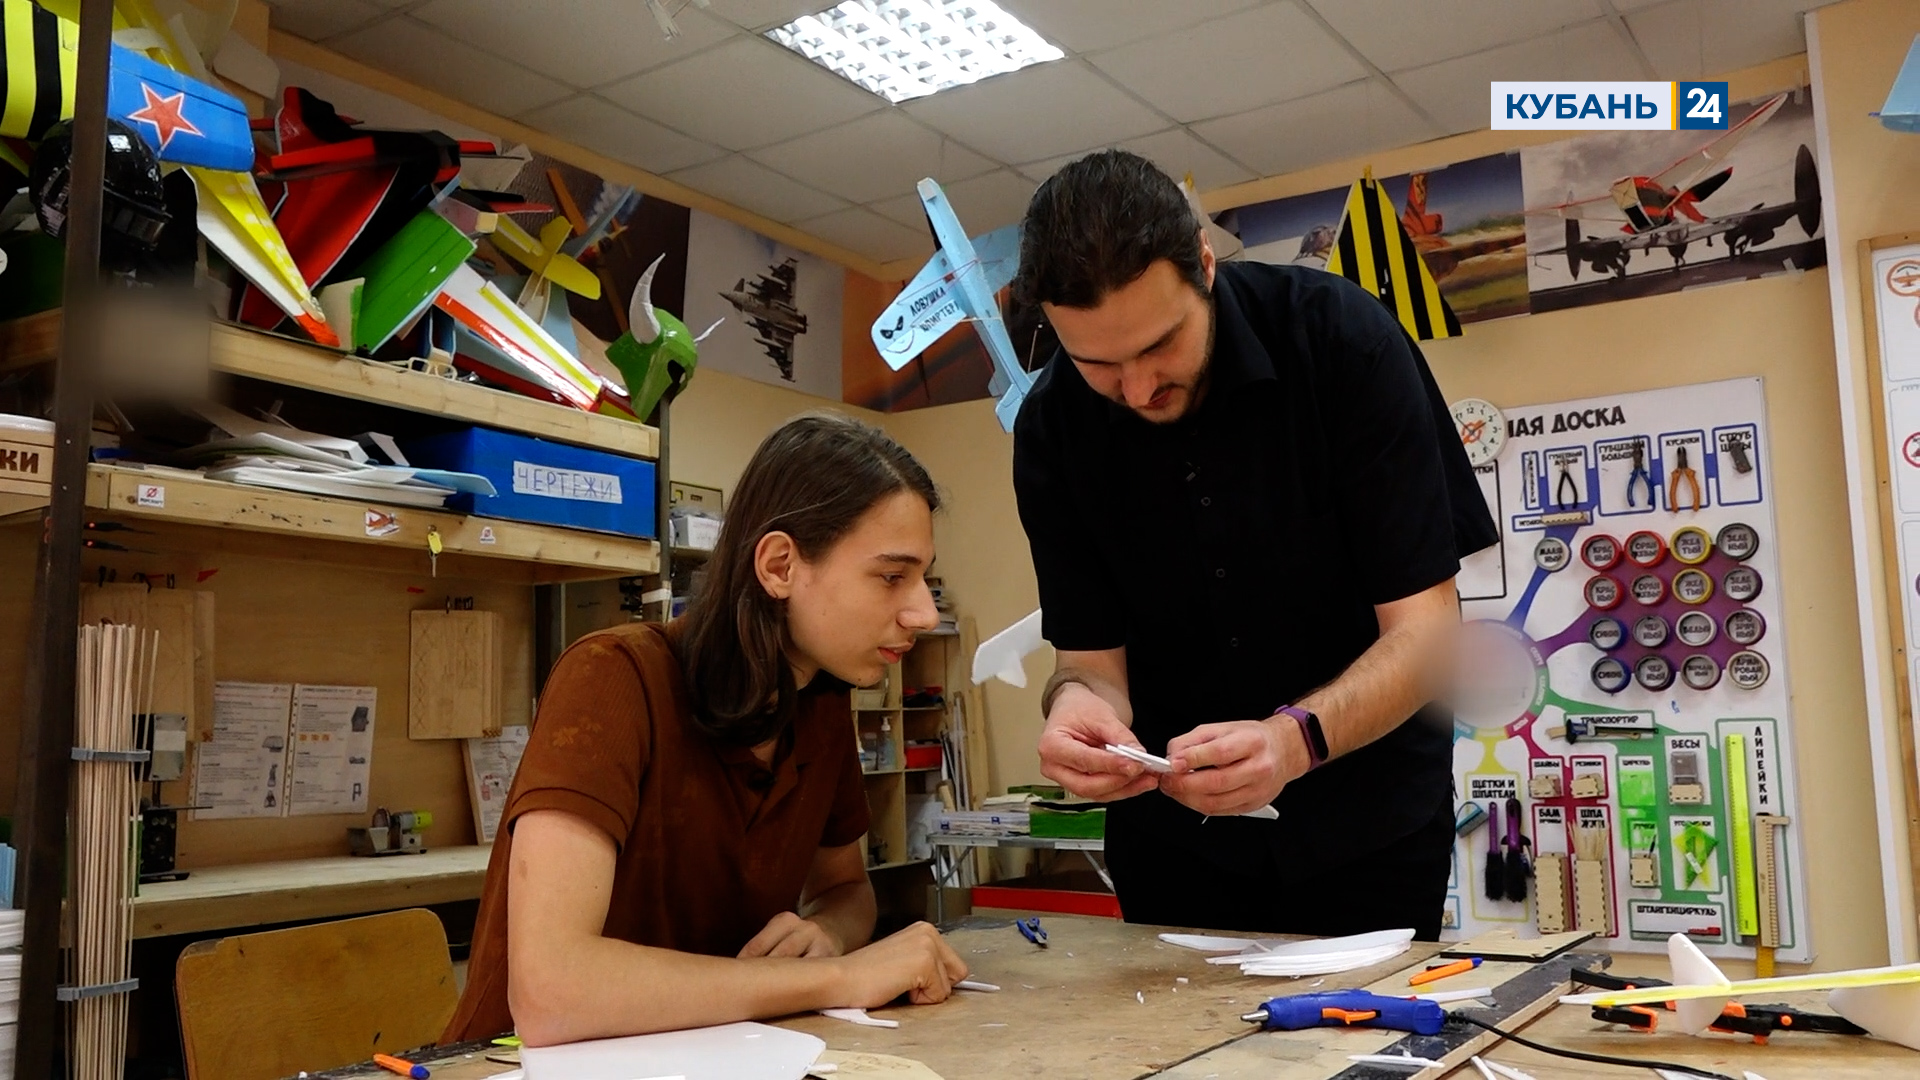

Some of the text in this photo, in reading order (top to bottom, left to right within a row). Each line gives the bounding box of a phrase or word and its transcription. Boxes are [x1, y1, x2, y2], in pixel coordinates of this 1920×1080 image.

[910, 286, 946, 316] ЛОВУШКА
[1551, 405, 1626, 433] ДОСКА
[1666, 436, 1700, 447] КУСАЧКИ
[1601, 451, 1635, 462] БОЛЬШ
[518, 467, 612, 500] ЧЕРТЕЖИ
[1671, 739, 1700, 749] ВЕСЫ
[1754, 726, 1768, 804] ЛИНЕЙКИ
[1508, 779, 1515, 788] И
[1472, 789, 1516, 799] ШПАТЕЛИ
[1580, 809, 1603, 818] ШПА
[1637, 905, 1717, 916] ШТАНГЕНЦИРКУЛЬ
